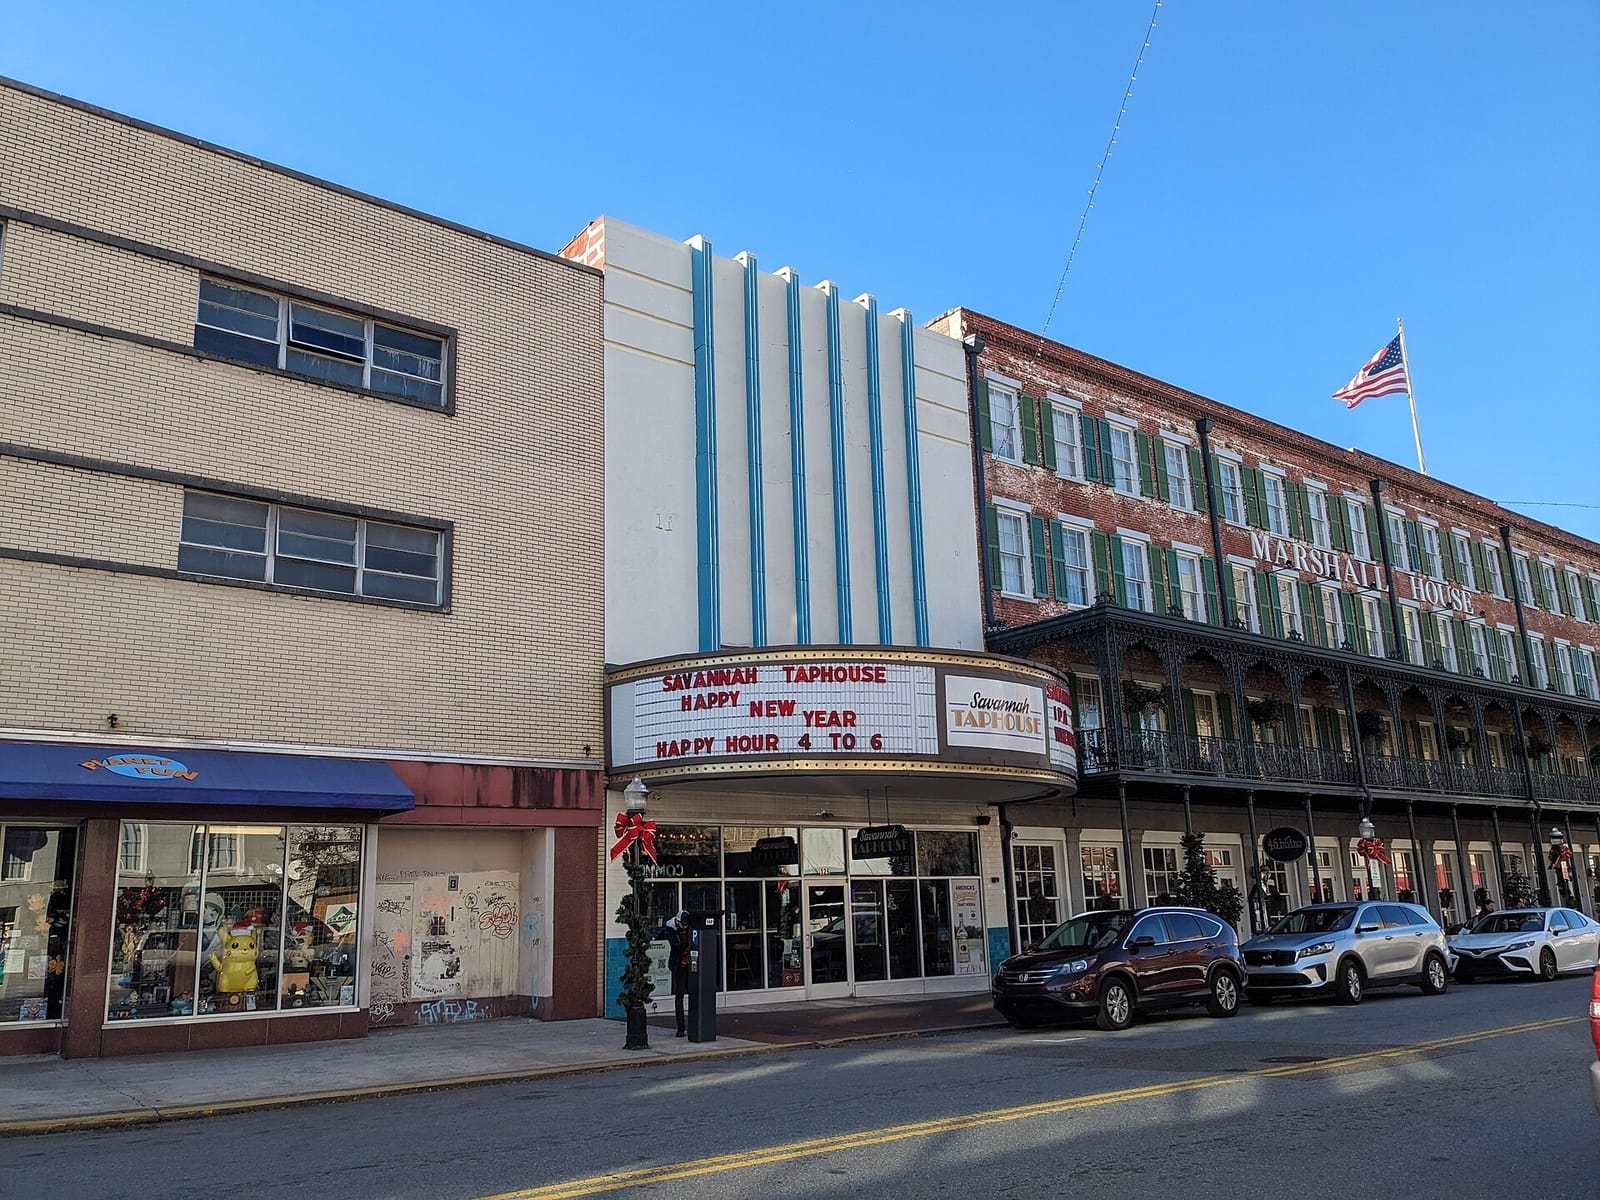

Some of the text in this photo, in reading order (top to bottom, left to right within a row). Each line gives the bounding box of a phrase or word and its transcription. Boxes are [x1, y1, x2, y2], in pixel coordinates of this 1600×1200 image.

[1250, 531, 1474, 615] MARSHALL HOUSE
[662, 666, 887, 692] SAVANNAH TAPHOUSE
[681, 691, 857, 727] HAPPY NEW YEAR
[970, 691, 1030, 714] Savannah
[951, 709, 1041, 735] TAPHOUSE
[656, 733, 883, 758] HAPPY HOUR 4 TO 6
[79, 757, 170, 771] PLANET
[135, 767, 199, 781] FUN
[859, 827, 900, 842] Savannah
